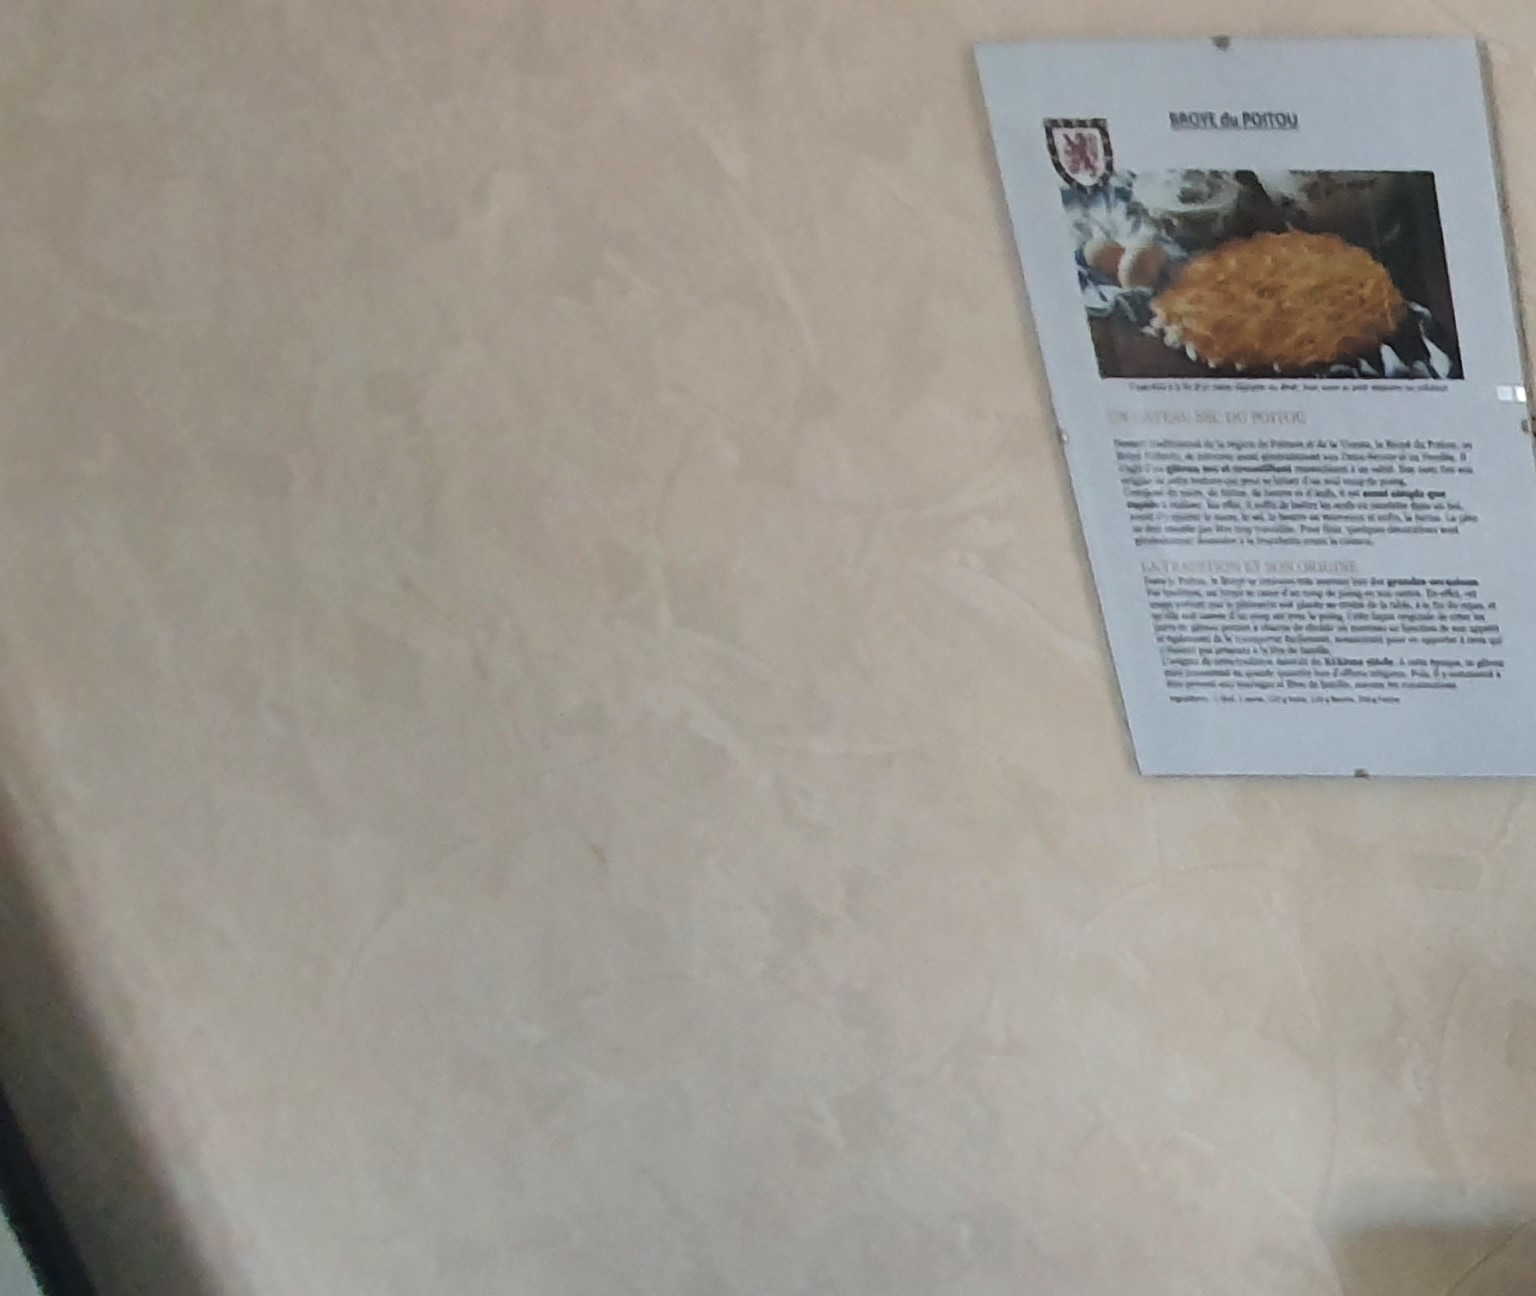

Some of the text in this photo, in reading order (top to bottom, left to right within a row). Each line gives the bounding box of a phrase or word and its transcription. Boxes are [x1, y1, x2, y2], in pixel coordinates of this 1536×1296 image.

[1169, 111, 1298, 130] BROYE du POITOU
